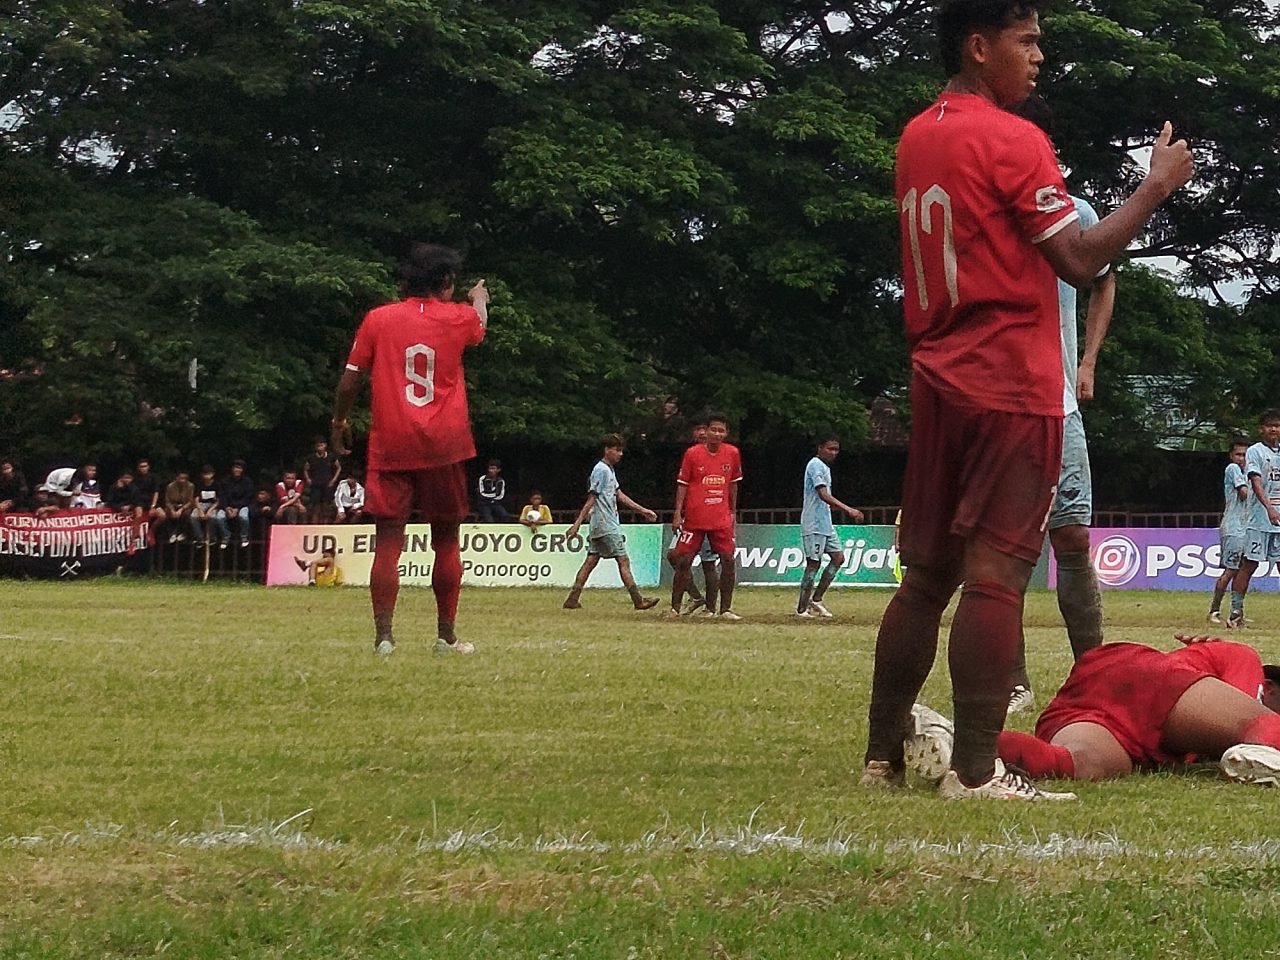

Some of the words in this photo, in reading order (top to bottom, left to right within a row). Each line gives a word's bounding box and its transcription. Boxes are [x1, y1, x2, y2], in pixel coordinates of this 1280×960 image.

[902, 183, 960, 311] 17
[405, 343, 436, 407] 9
[302, 534, 344, 554] UD.
[460, 533, 522, 553] JOYO
[814, 543, 821, 555] 3
[461, 560, 552, 581] Ponorogo
